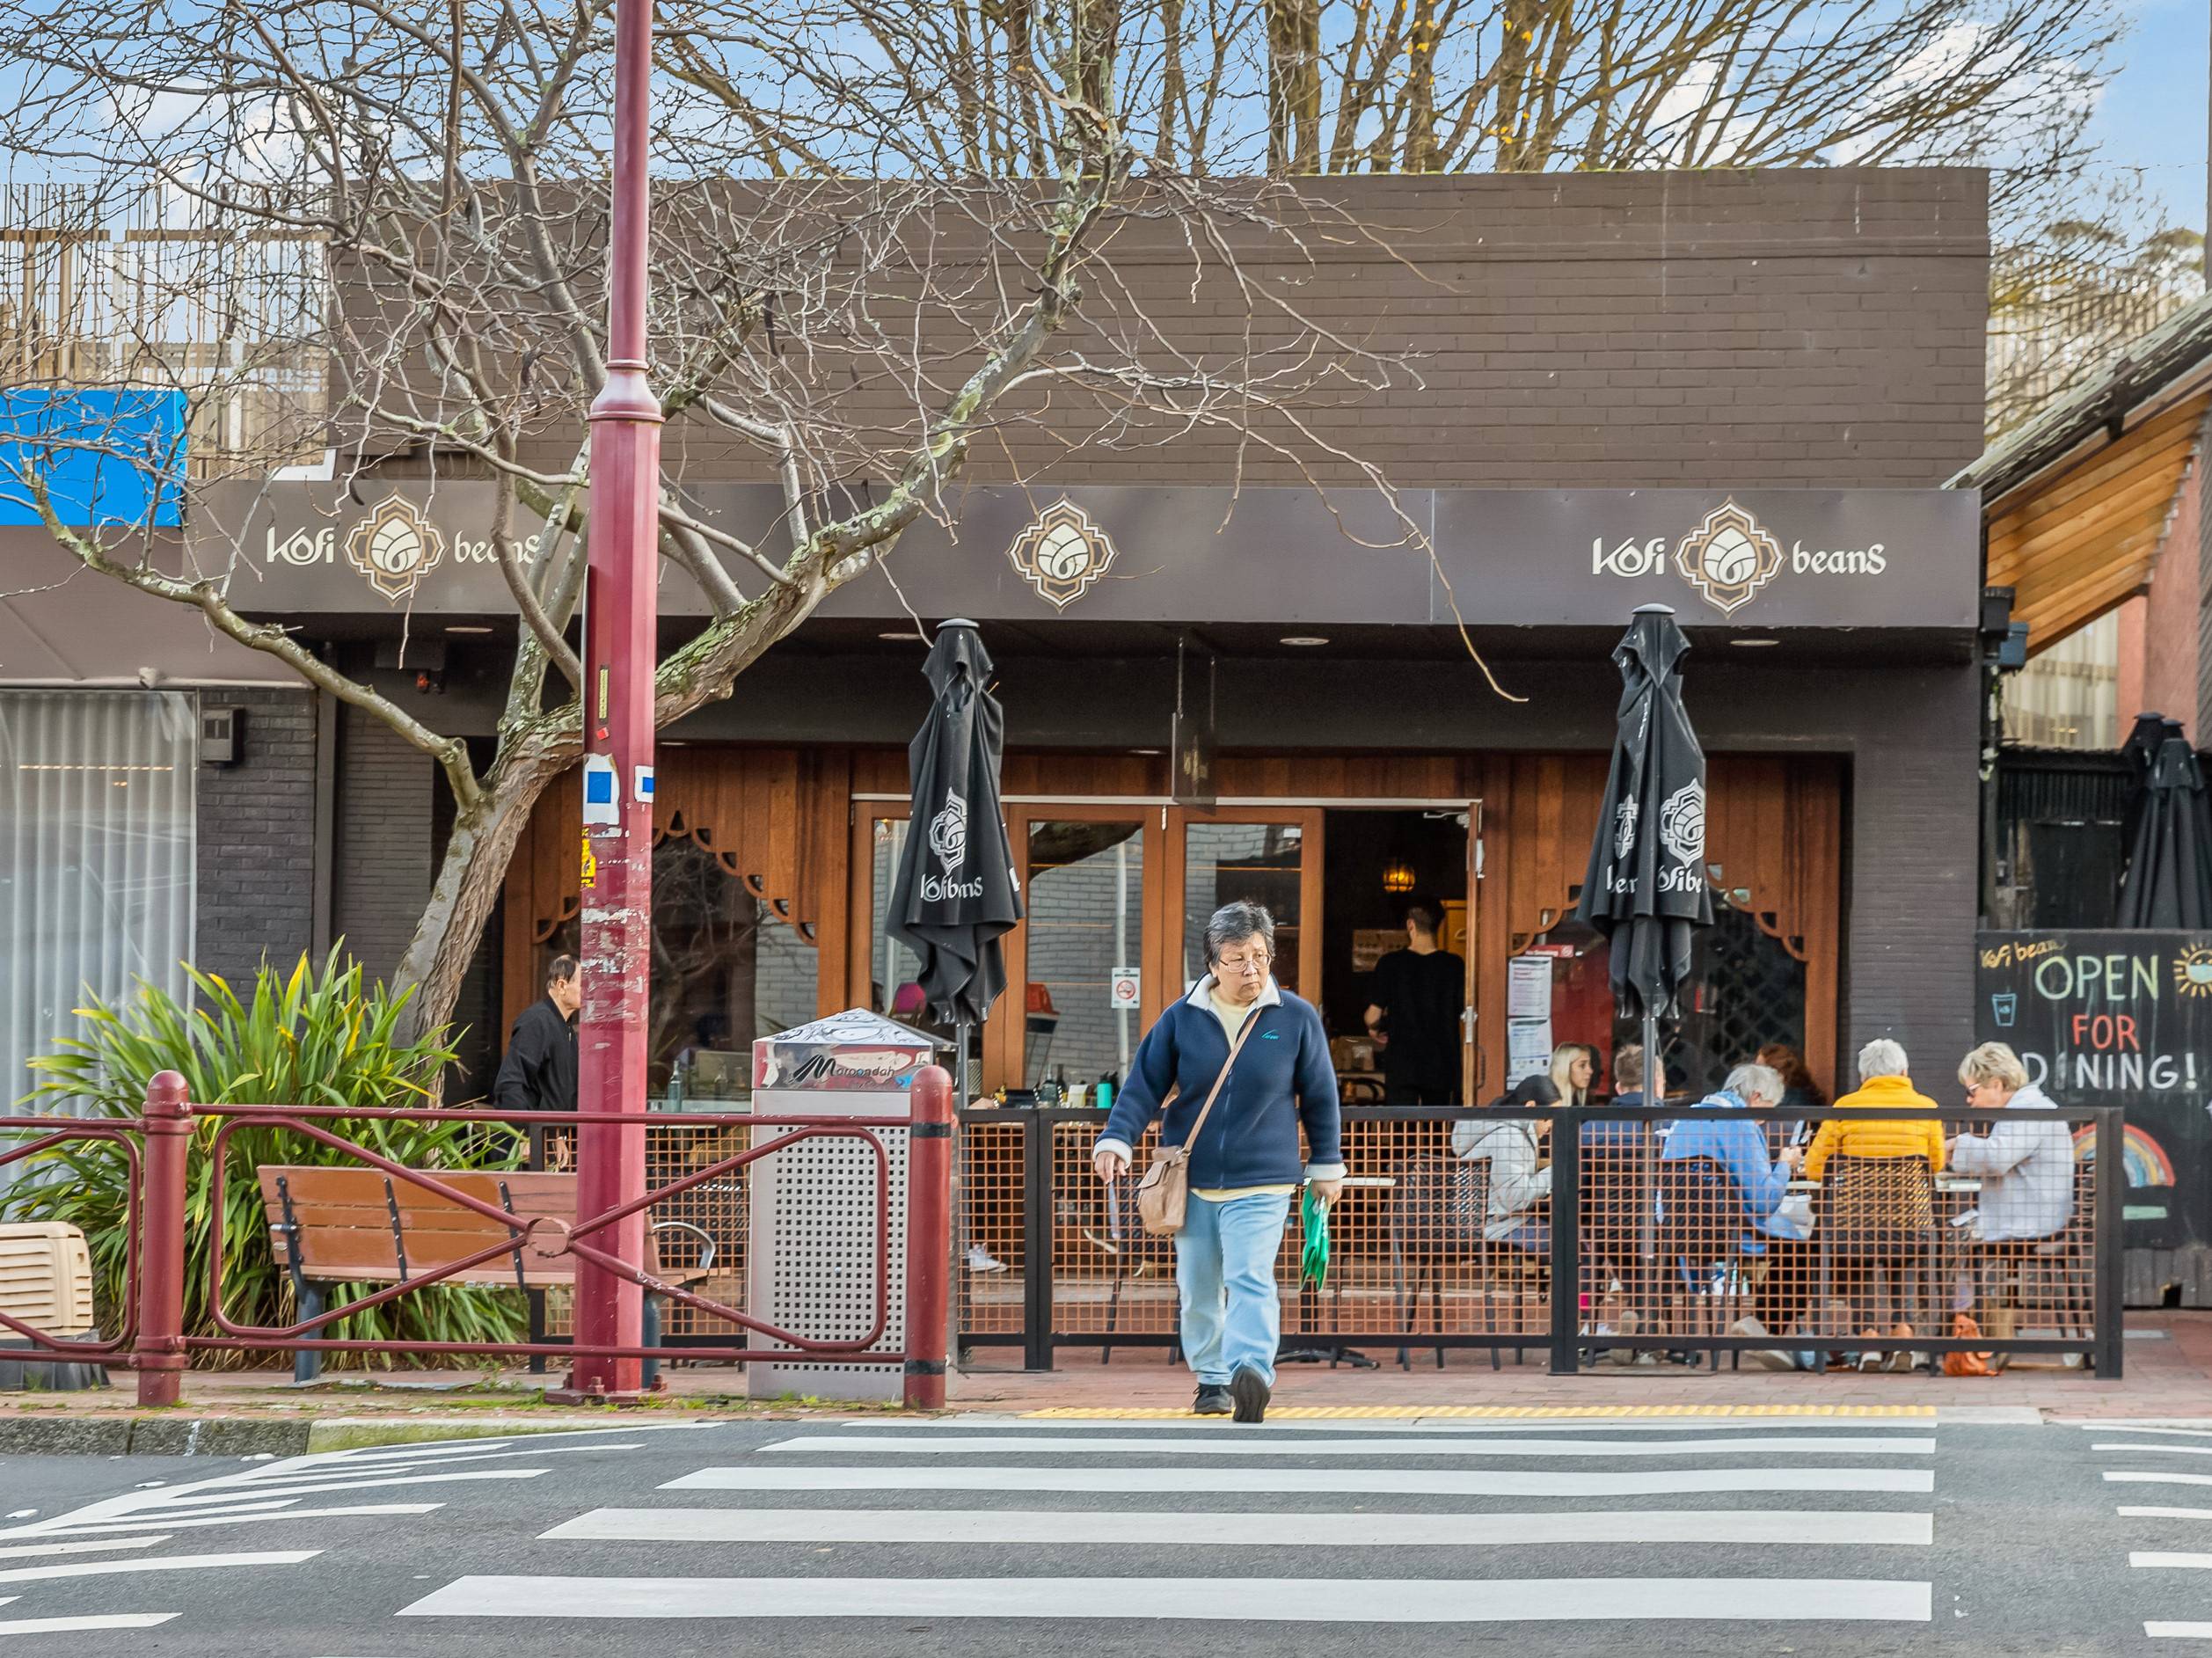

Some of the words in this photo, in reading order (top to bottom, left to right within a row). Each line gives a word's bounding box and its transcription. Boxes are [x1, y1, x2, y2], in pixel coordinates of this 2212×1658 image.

[2034, 954, 2159, 1001] OPEN
[2072, 1014, 2140, 1051] FOR
[791, 1054, 894, 1083] Maroondah
[2021, 1051, 2198, 1090] DINING!
